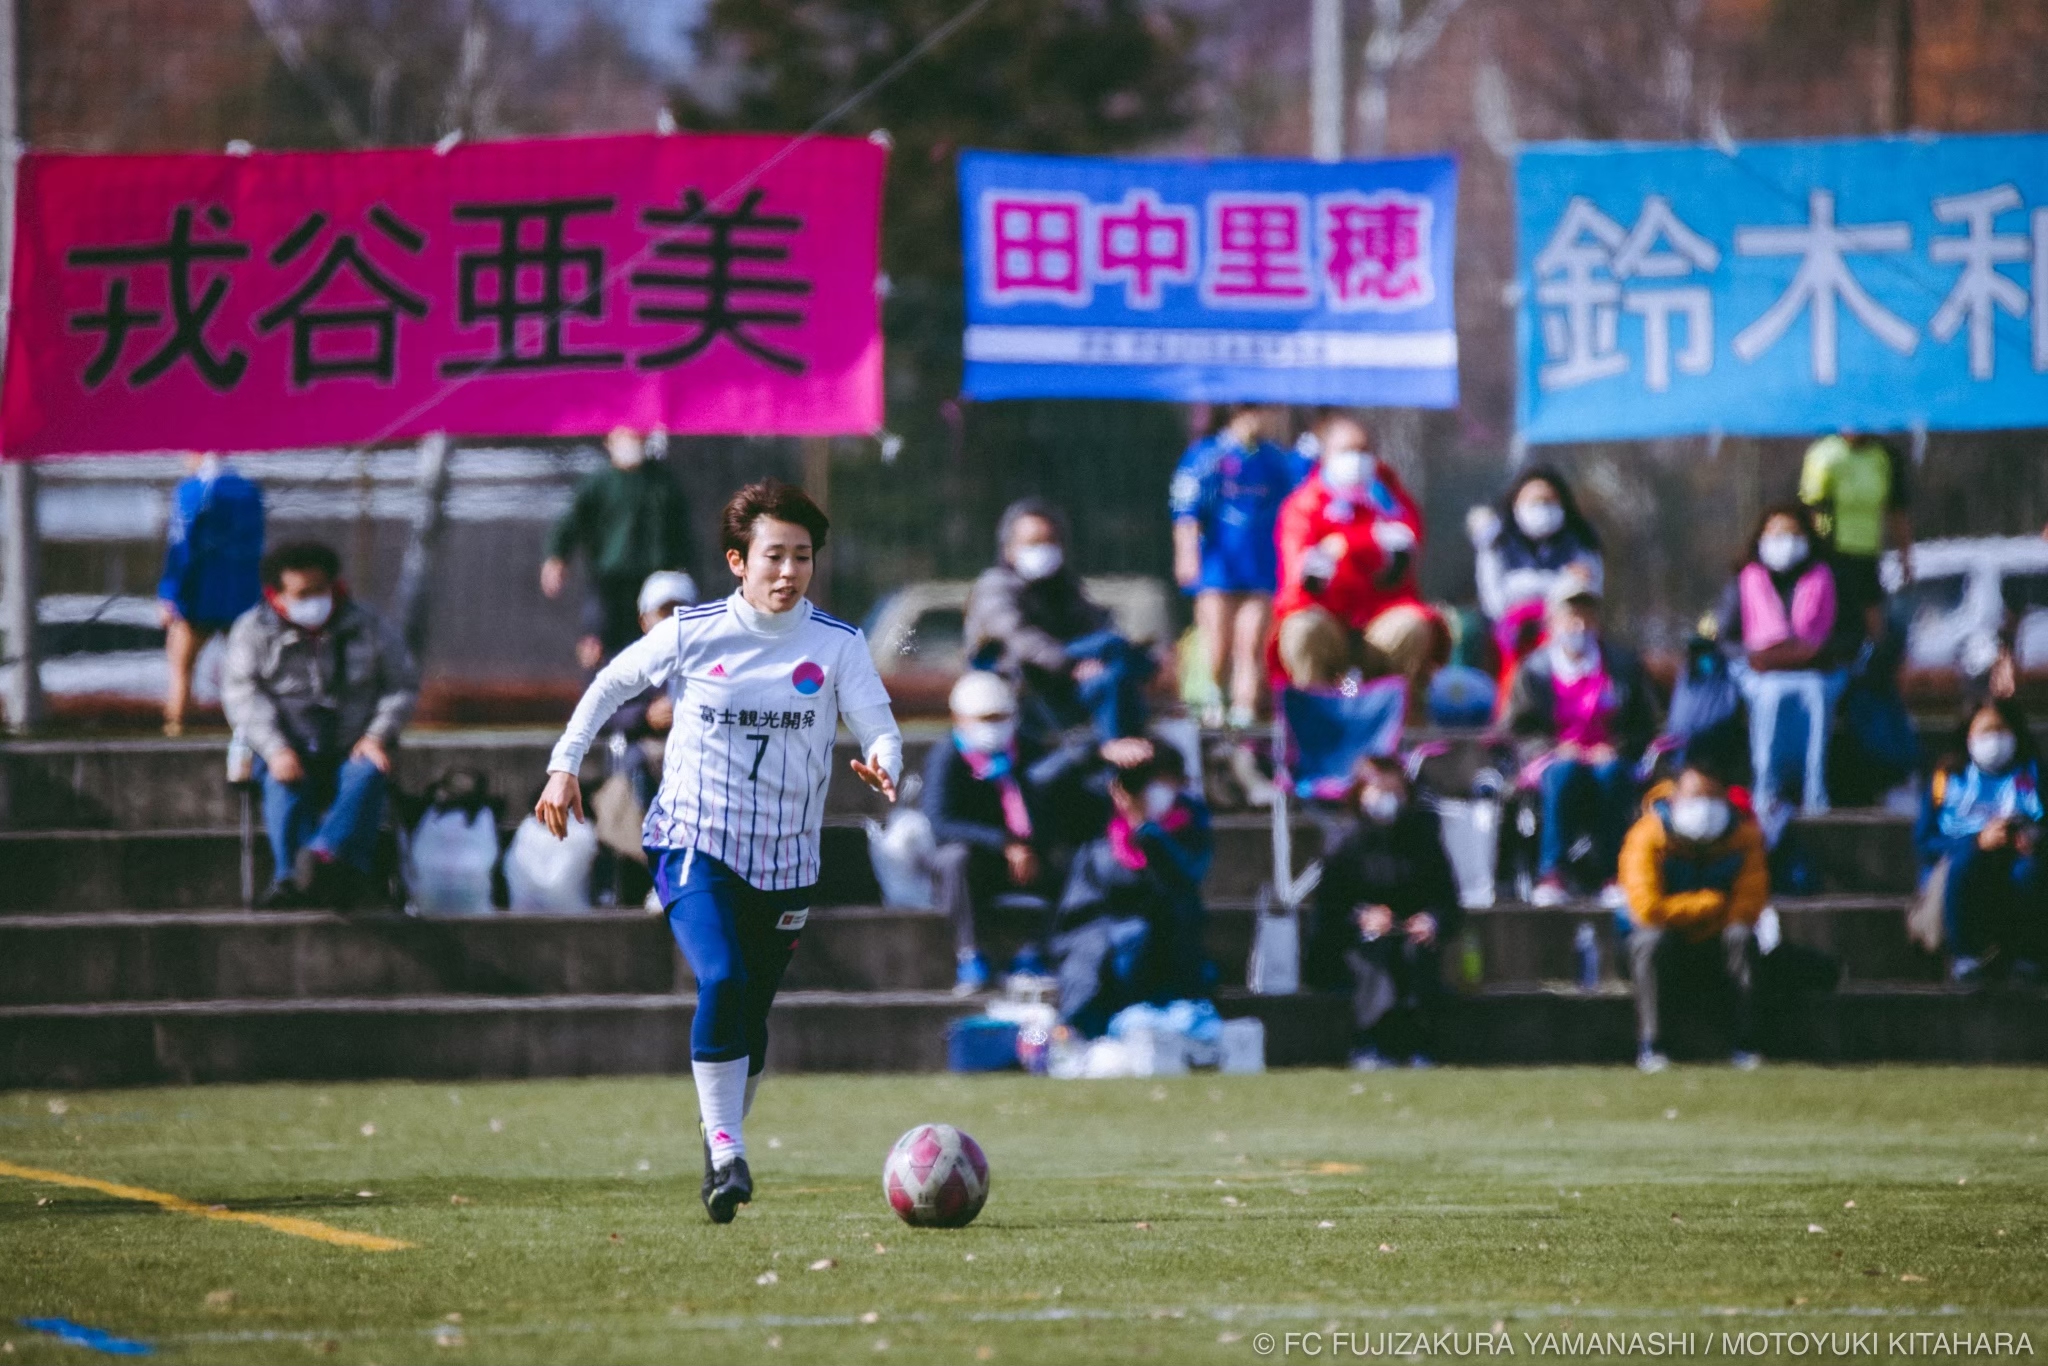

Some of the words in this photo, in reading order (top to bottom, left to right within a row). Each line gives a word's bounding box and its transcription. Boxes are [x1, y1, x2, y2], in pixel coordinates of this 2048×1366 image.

[67, 188, 812, 390] 戎谷亜美
[983, 190, 1433, 311] 田中里穂
[699, 704, 816, 730] 富士観光開発
[745, 733, 770, 781] 7
